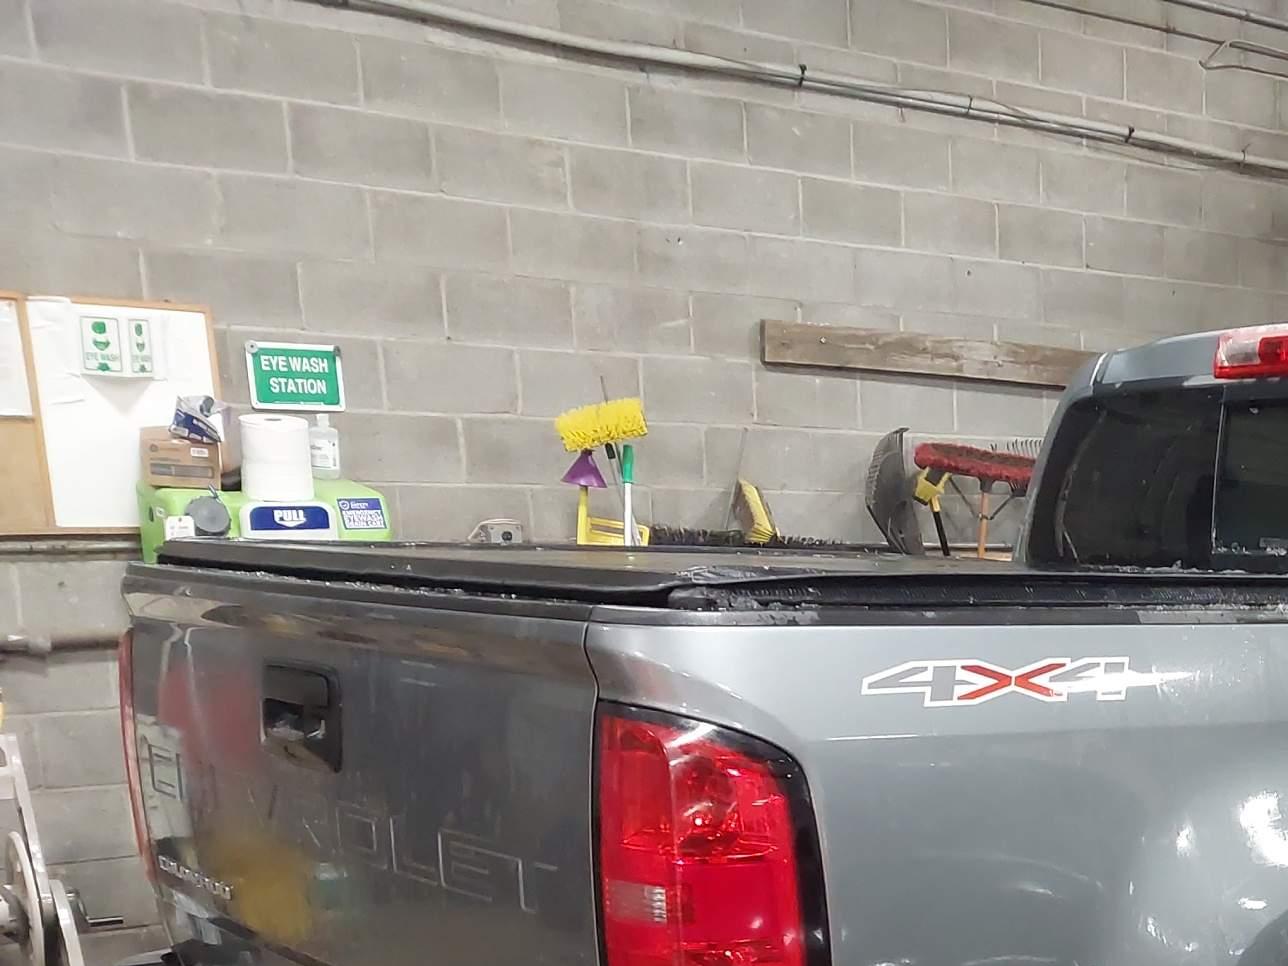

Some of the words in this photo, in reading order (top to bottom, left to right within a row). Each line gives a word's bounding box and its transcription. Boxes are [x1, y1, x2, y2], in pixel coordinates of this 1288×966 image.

[260, 355, 288, 371] EYE
[288, 356, 329, 373] WASH
[269, 377, 327, 394] STATION
[272, 509, 305, 521] PULL
